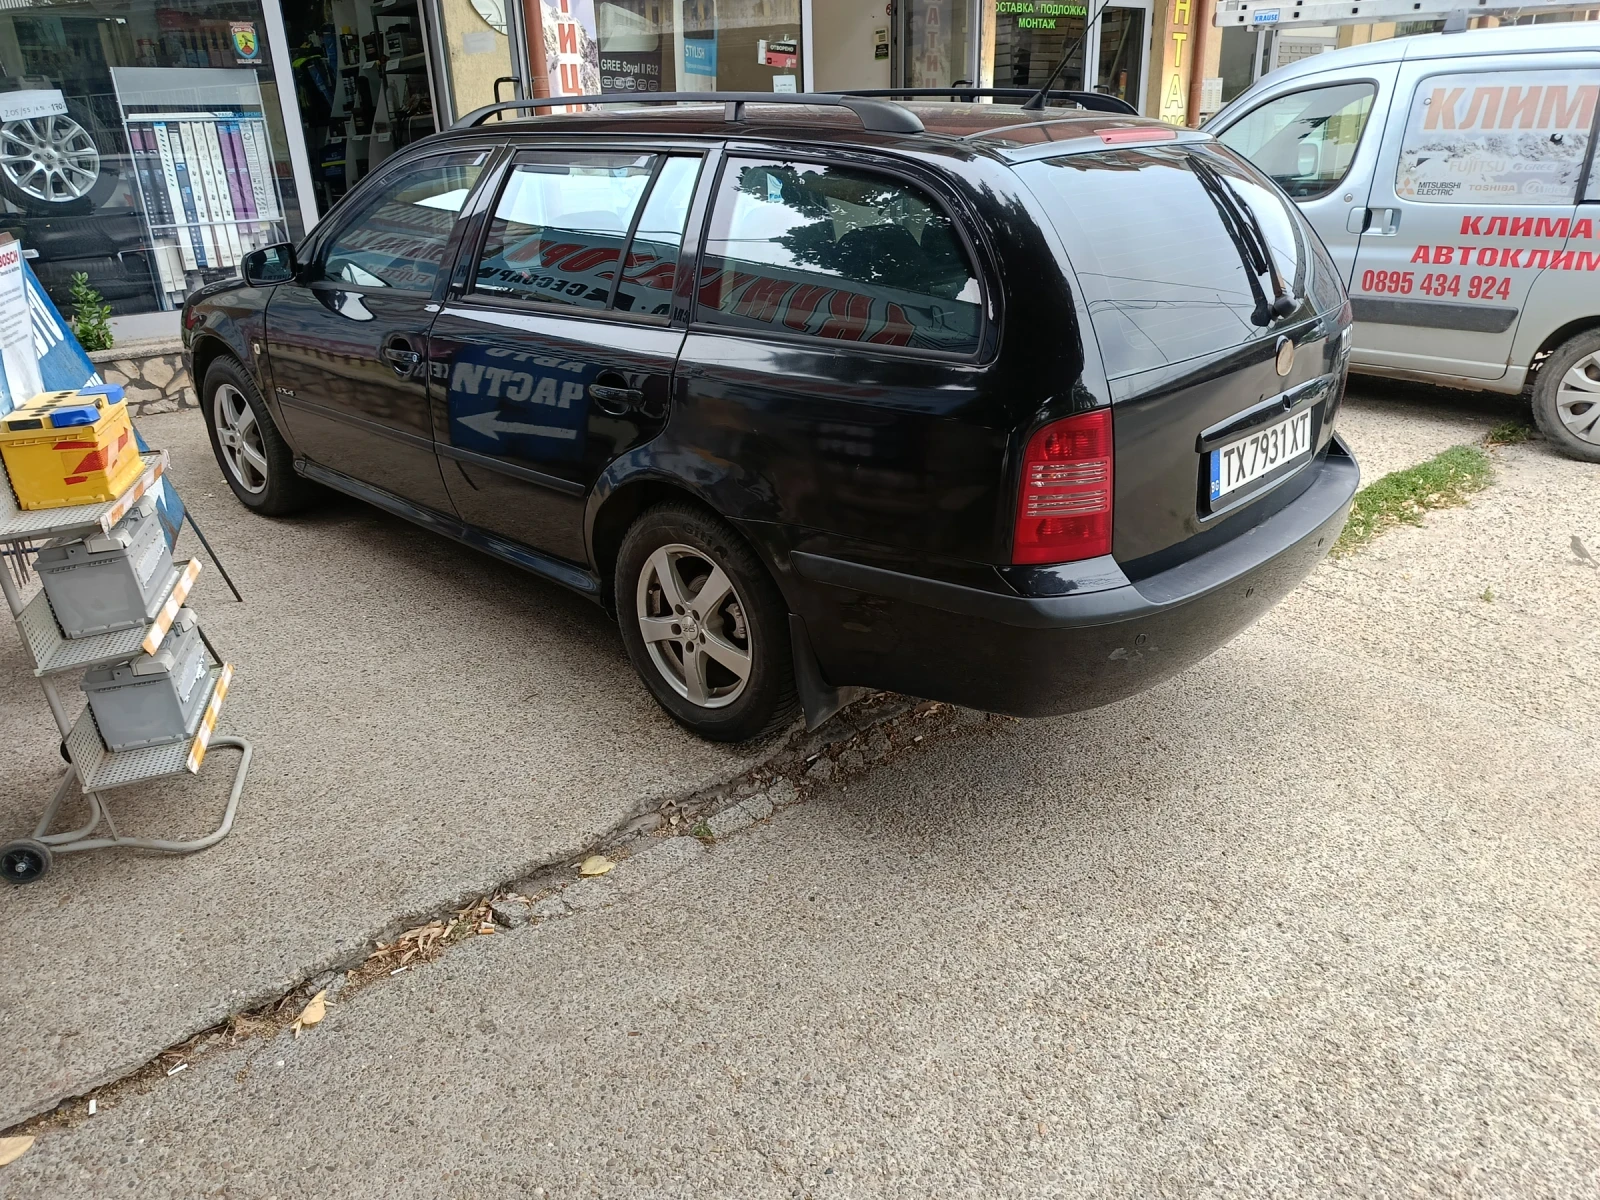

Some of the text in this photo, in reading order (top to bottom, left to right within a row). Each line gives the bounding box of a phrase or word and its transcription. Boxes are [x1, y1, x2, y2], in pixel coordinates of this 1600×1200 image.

[1040, 4, 1087, 16] ПОДЛОЖКА
[1018, 18, 1056, 29] МОНТАЖ
[1254, 14, 1278, 22] KRAUSE
[685, 44, 705, 59] STYLISH
[600, 59, 621, 72] GREE
[622, 61, 640, 76] Soyal
[646, 64, 659, 76] R32
[1423, 85, 1600, 130] КЛИМ
[1449, 155, 1506, 175] FUJITSU
[1524, 163, 1554, 171] GREE
[1418, 181, 1462, 189] MITSUBISHI
[1469, 184, 1516, 192] TOSHIBA
[1460, 216, 1600, 239] КЛИМА
[1361, 269, 1511, 301] 0895 434 924
[1211, 480, 1220, 493] BG
